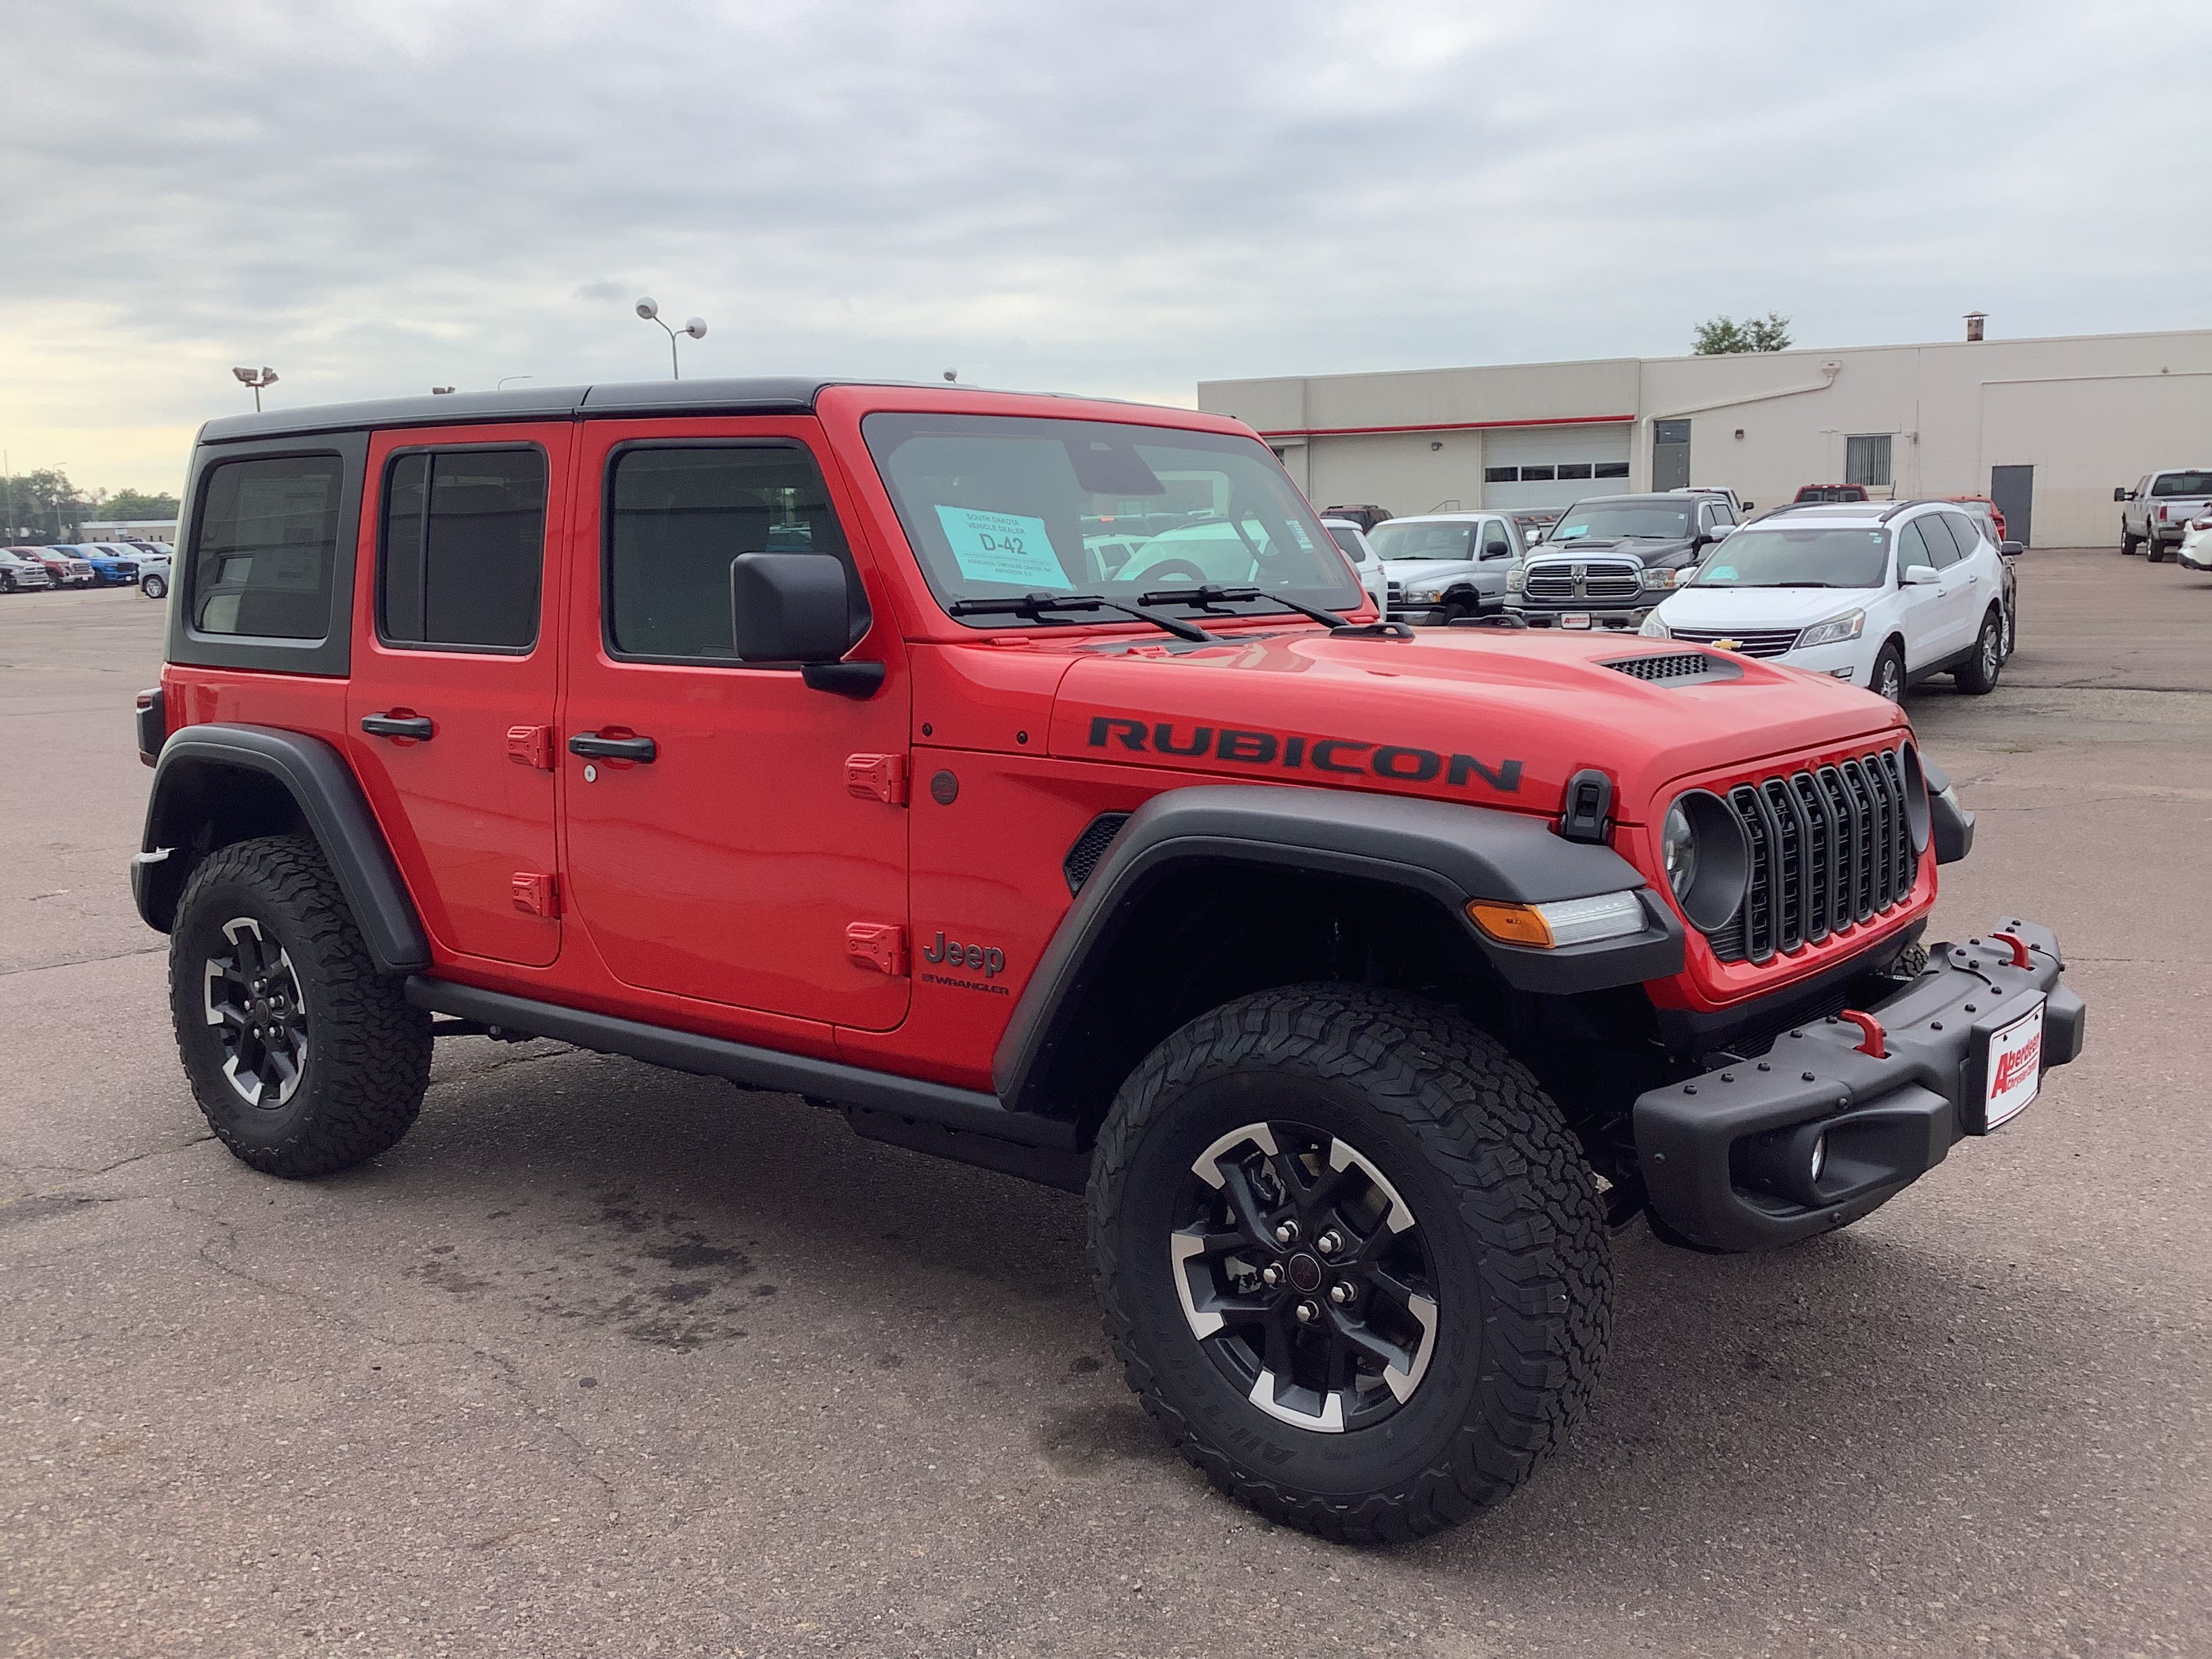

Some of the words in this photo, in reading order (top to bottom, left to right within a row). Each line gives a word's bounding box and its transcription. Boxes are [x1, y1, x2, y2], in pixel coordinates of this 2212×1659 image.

[966, 513, 991, 522] SOUTH
[991, 516, 1020, 526] DAKOTA
[967, 522, 998, 531] VEHICLE
[998, 526, 1026, 535] DEALER
[979, 533, 1027, 555] D-42
[1088, 716, 1524, 792] RUBICON
[923, 930, 1006, 978] Jeep
[935, 975, 1009, 996] WRANGLER
[1991, 1033, 2039, 1099] Aberdeen
